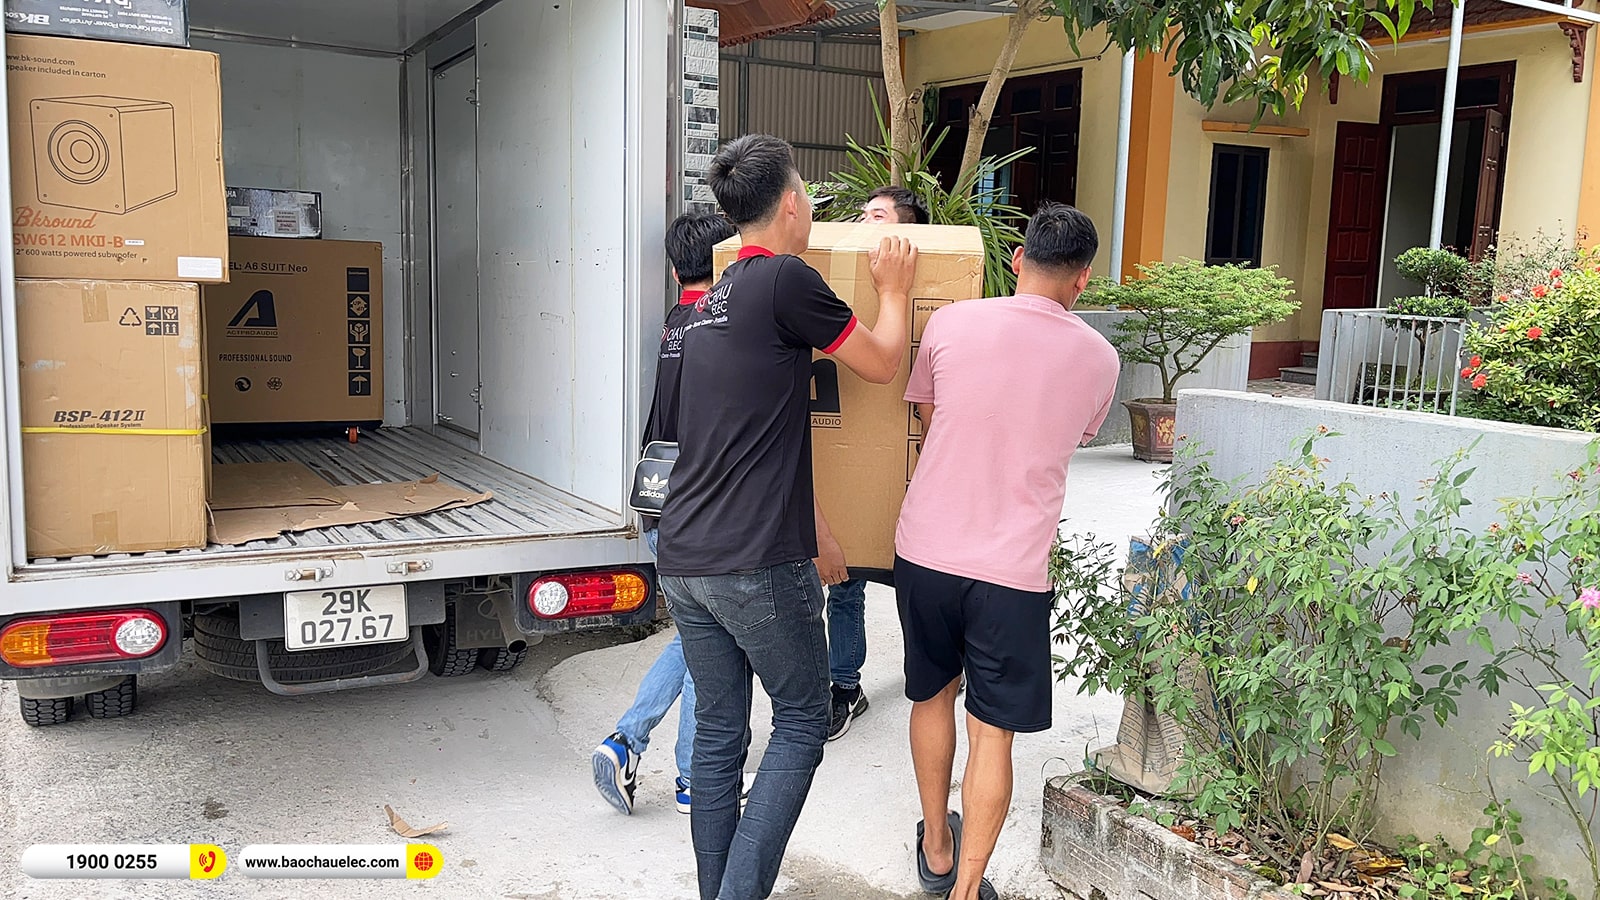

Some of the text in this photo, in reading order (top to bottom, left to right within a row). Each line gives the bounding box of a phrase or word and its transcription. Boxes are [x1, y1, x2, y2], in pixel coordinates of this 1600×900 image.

[94, 20, 119, 29] Power
[38, 66, 71, 75] included
[13, 233, 66, 247] SW612
[25, 248, 40, 256] 600
[41, 249, 62, 257] watts
[98, 251, 137, 259] subwoofer
[244, 262, 258, 270] A6
[260, 262, 285, 272] SUIT
[288, 264, 308, 272] Neo
[218, 353, 292, 362] PROFESSIONAL SOUND
[639, 490, 665, 499] adidas
[321, 589, 372, 616] 29K
[301, 614, 393, 645] 027.67
